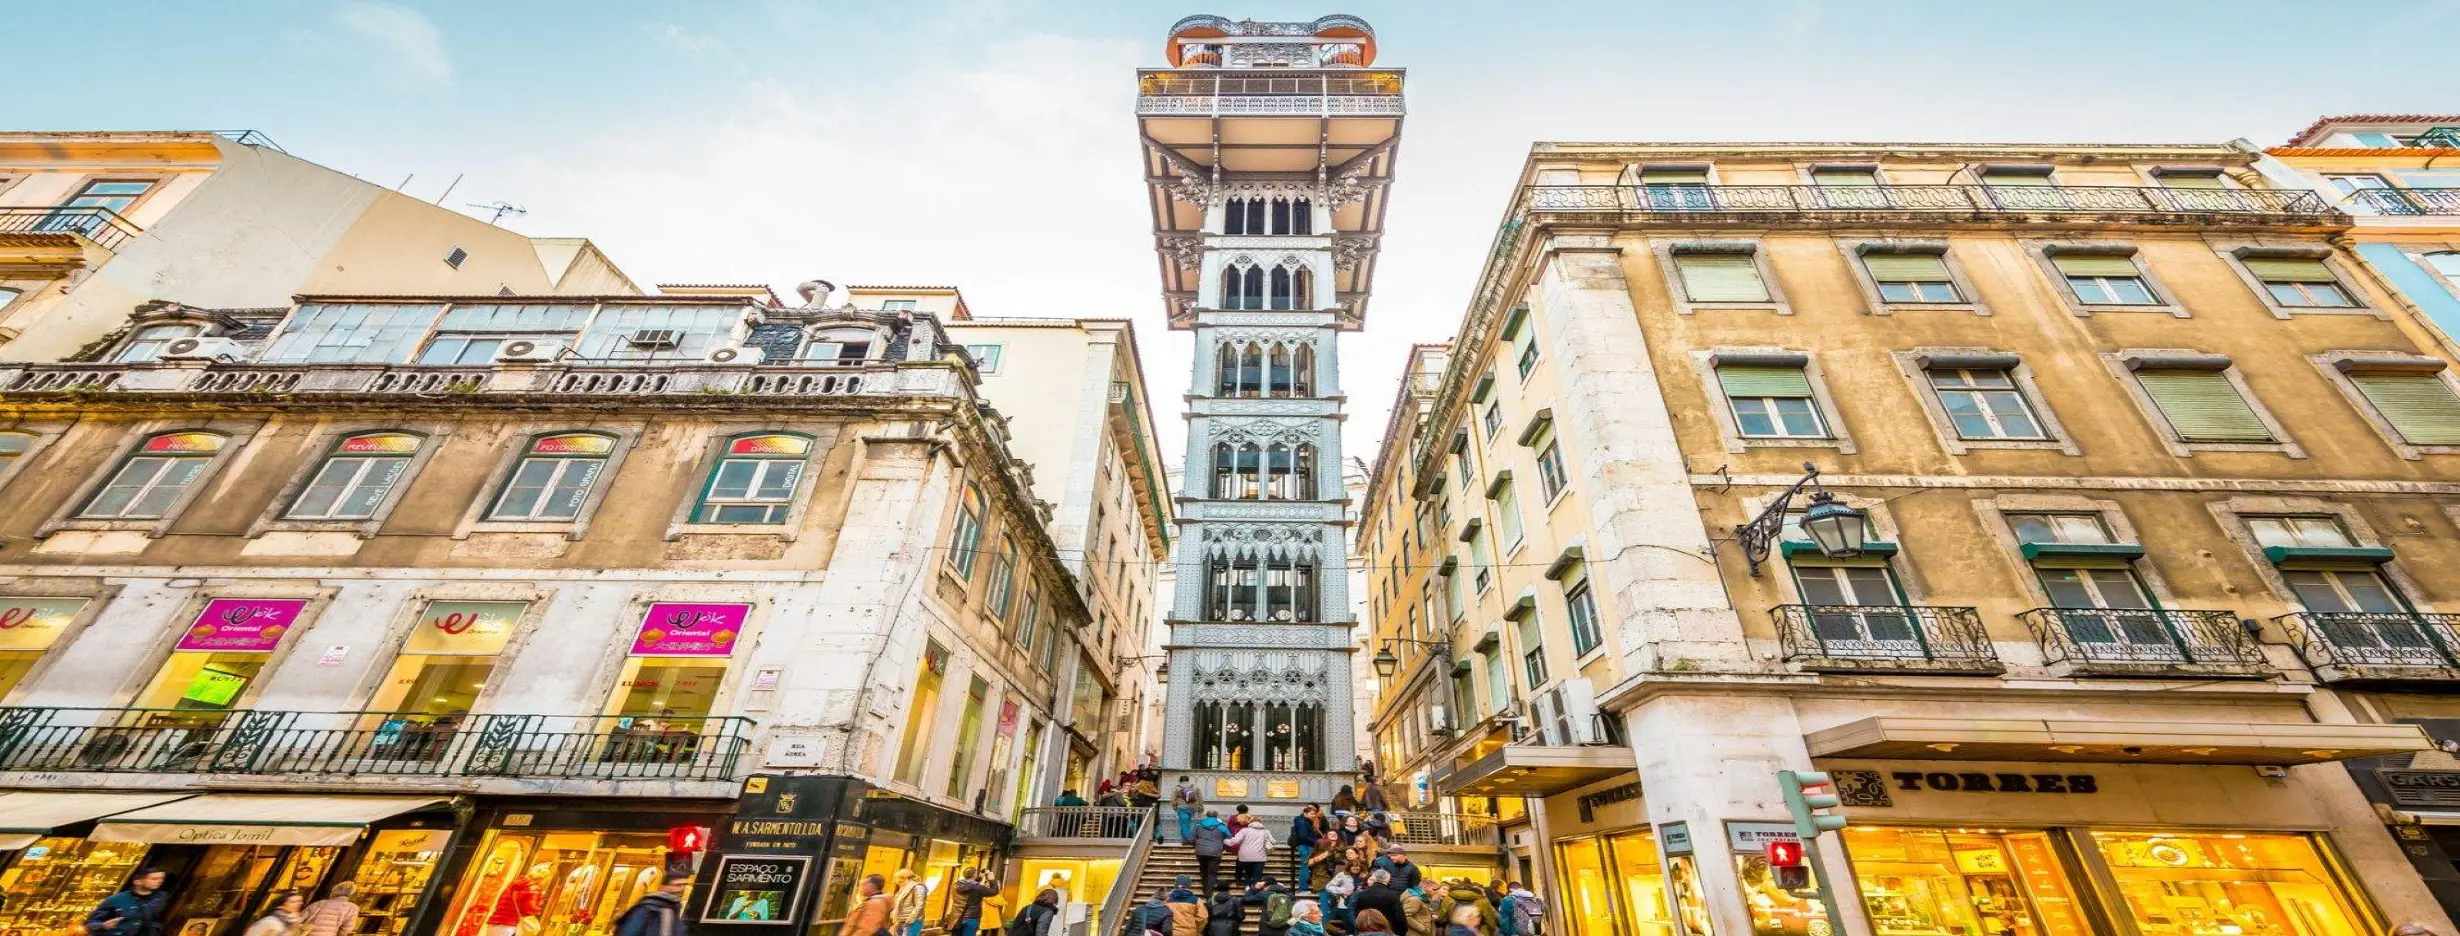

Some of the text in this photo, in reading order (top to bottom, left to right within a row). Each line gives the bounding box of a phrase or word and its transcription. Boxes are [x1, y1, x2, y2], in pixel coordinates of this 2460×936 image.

[669, 629, 711, 637] Oriental
[1892, 772, 2098, 793] TORRES
[729, 863, 779, 874] ESPAÇO
[726, 873, 793, 884] SARMENTO
